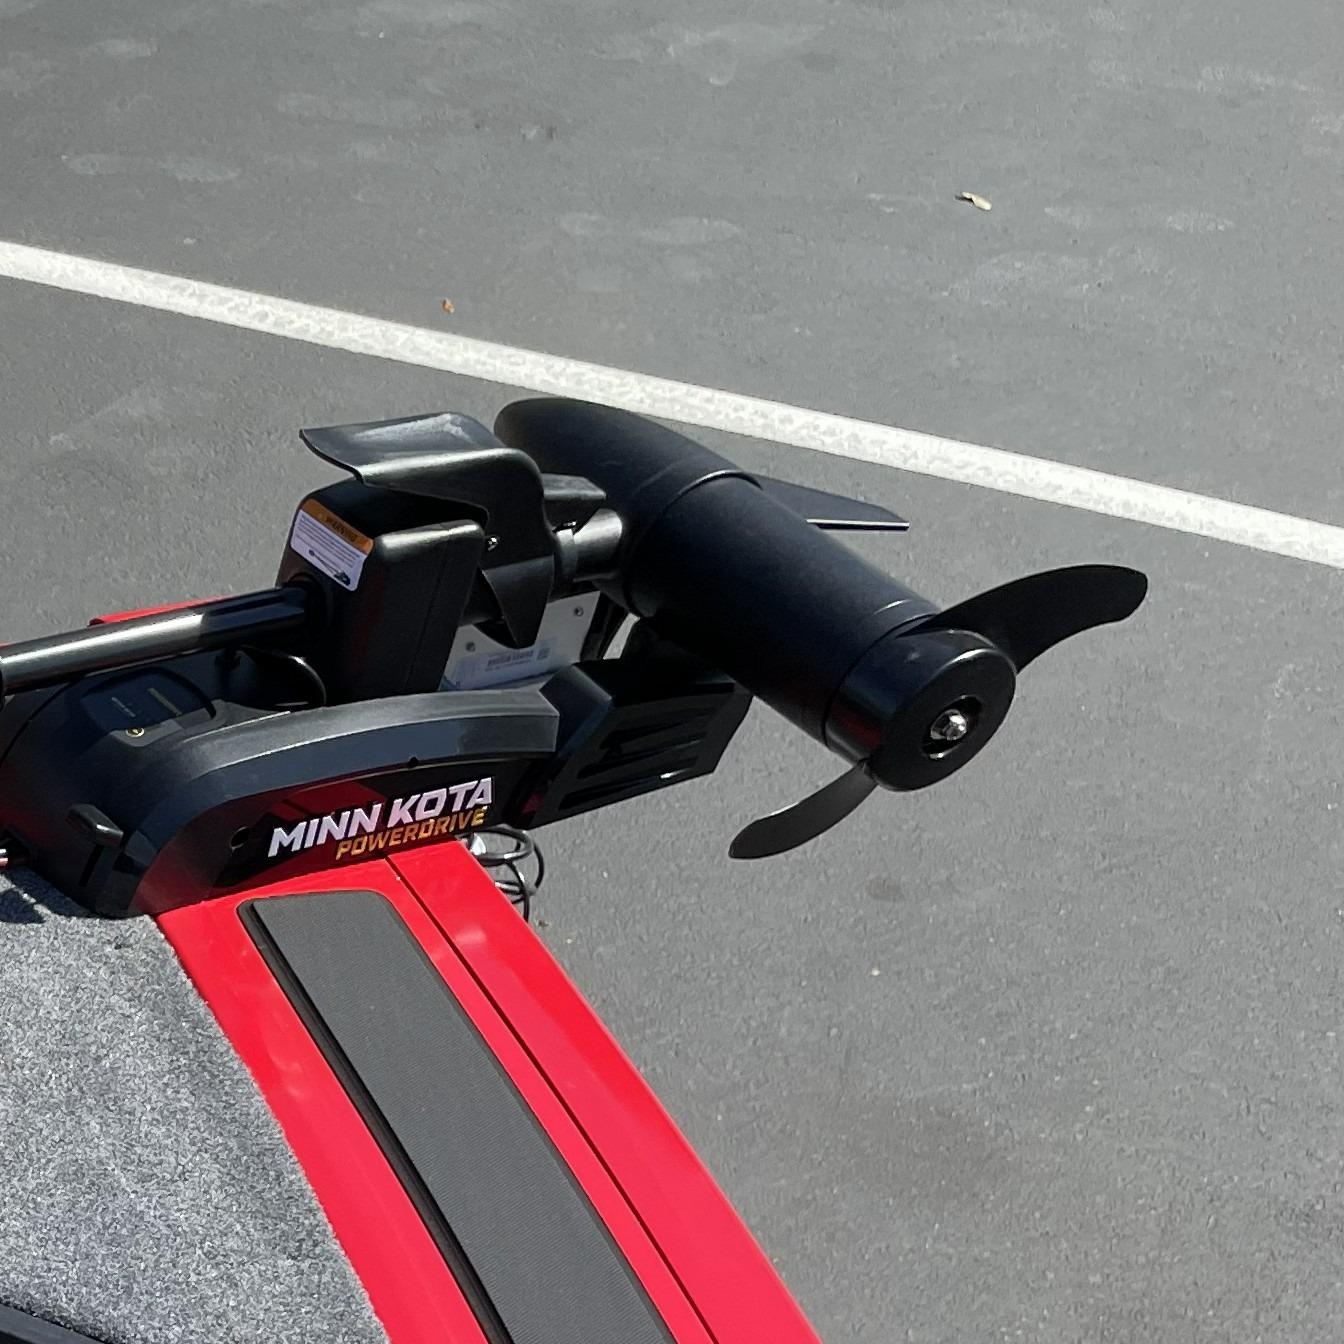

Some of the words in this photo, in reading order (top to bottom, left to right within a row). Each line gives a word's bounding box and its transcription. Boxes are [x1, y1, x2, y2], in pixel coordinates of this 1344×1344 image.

[267, 803, 382, 858] MINN
[387, 777, 493, 829] KOTA
[335, 805, 489, 861] POWERDRIVE
